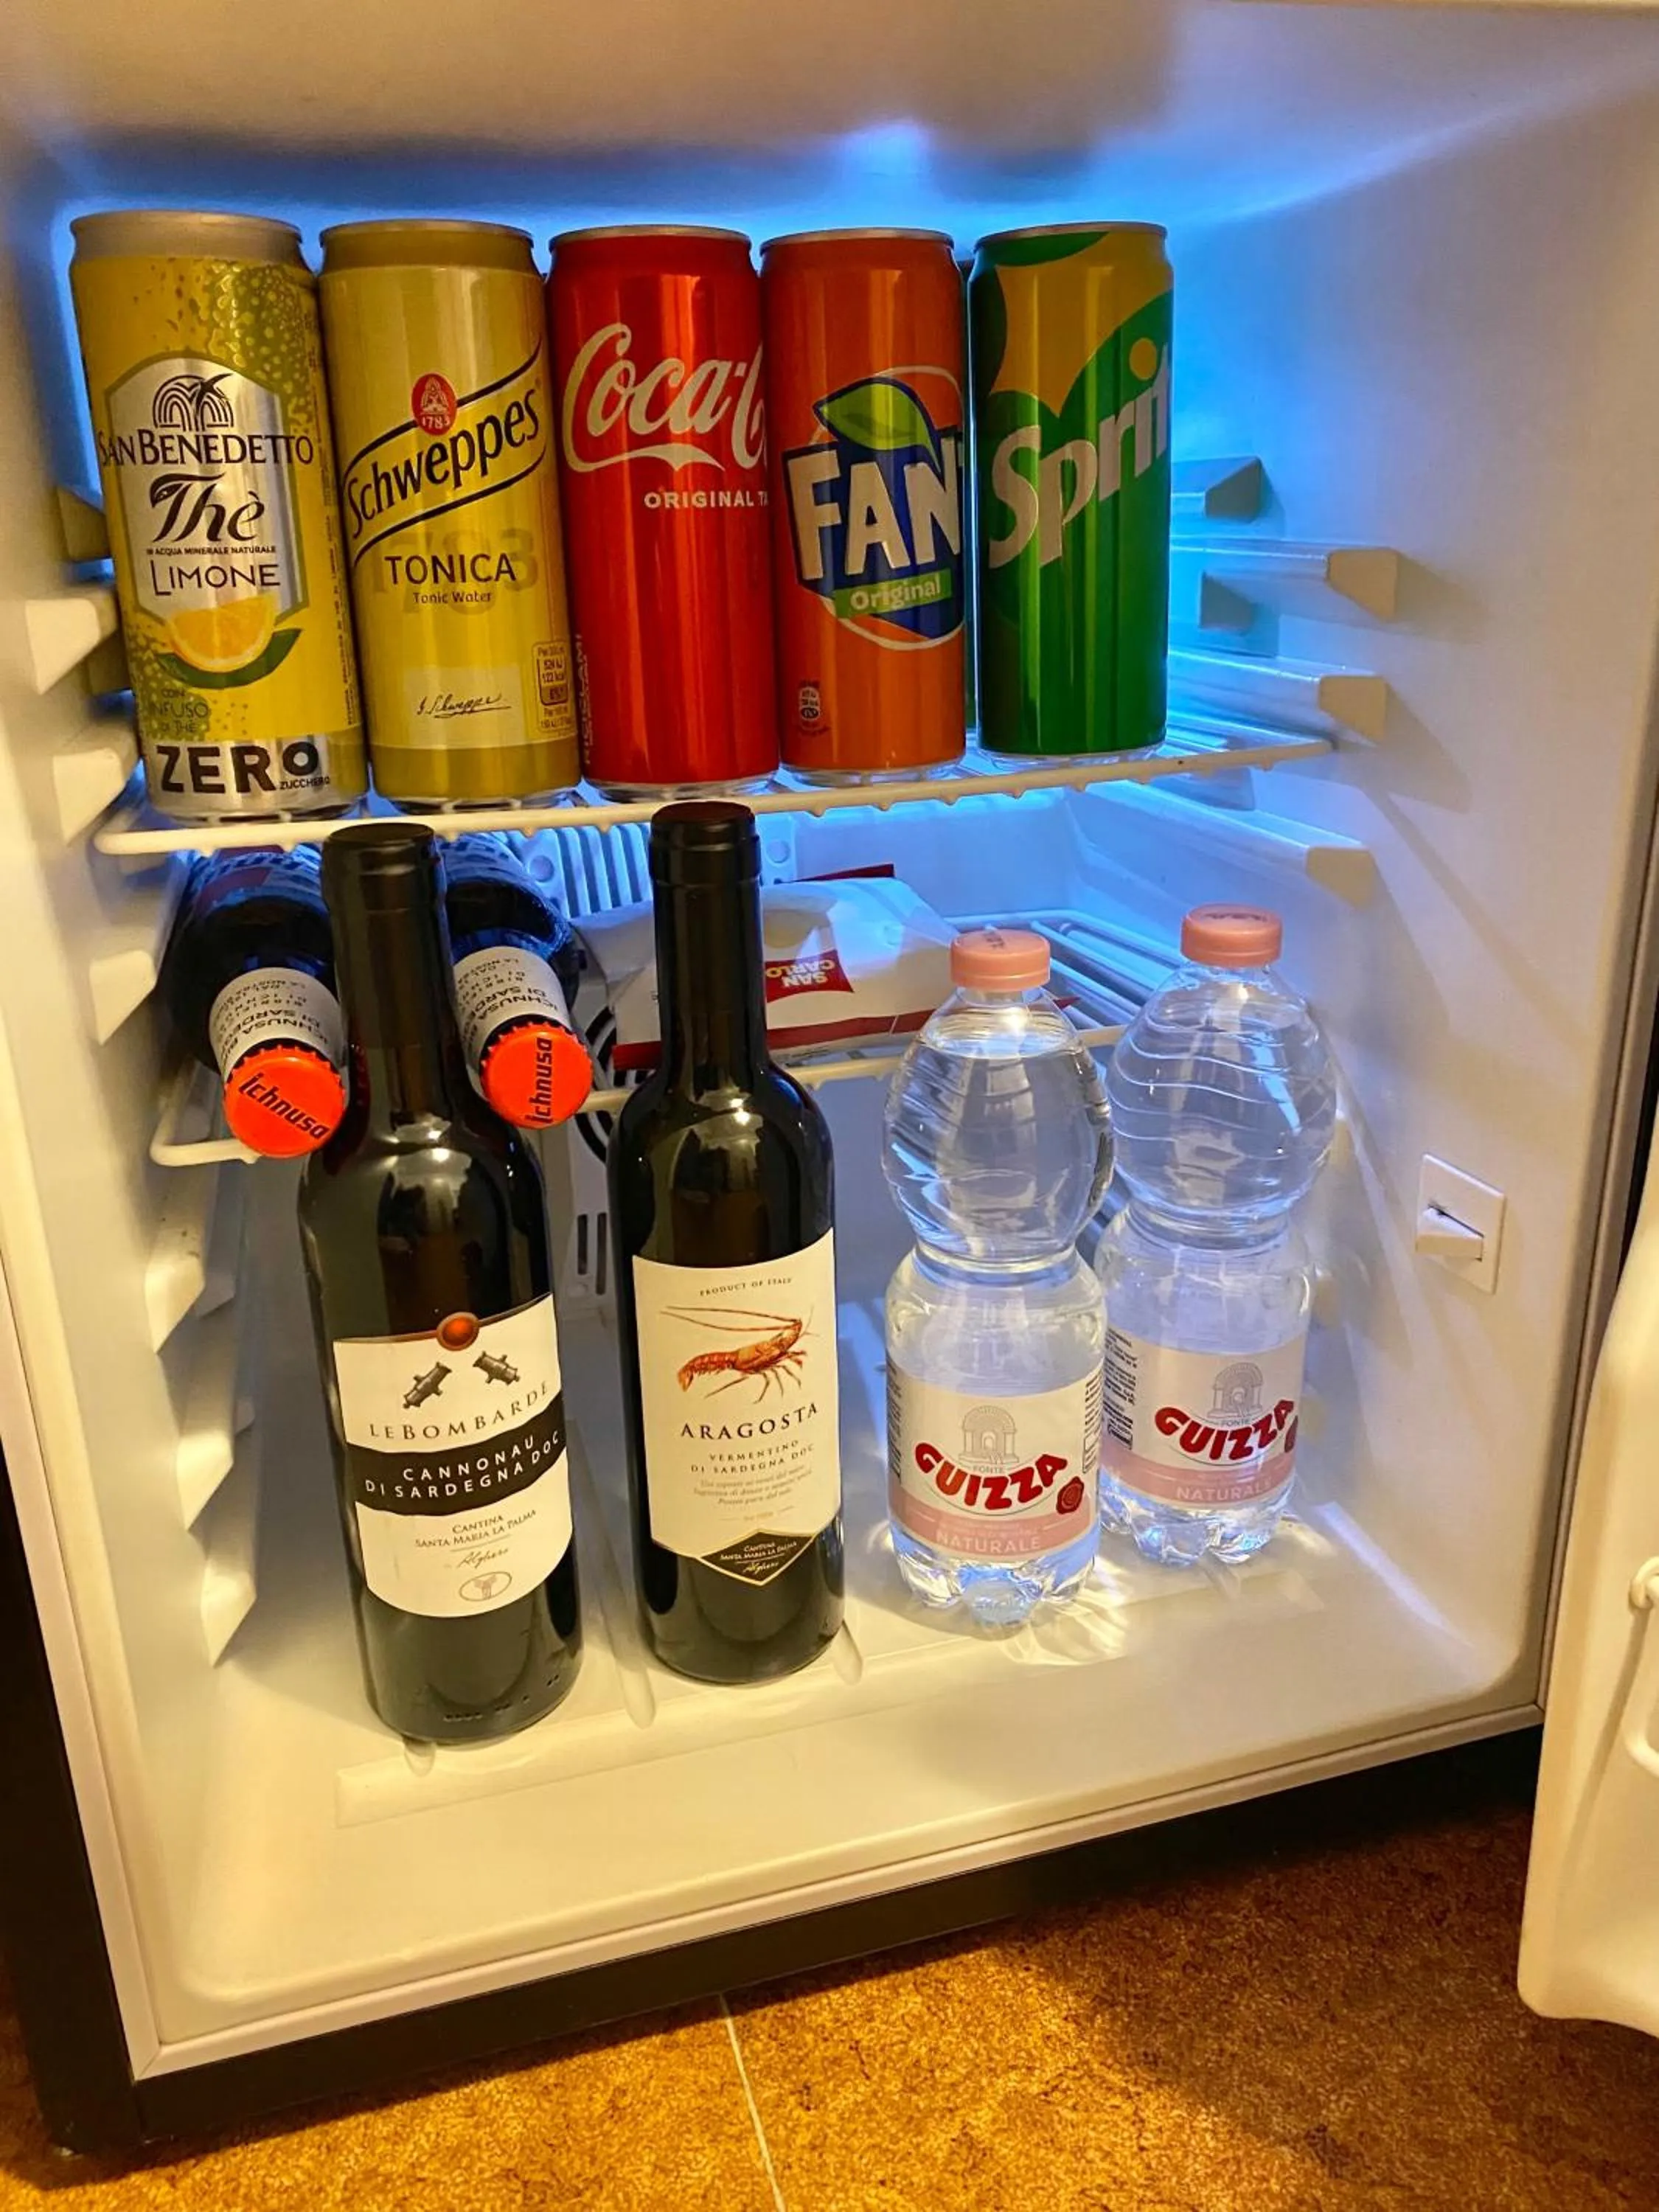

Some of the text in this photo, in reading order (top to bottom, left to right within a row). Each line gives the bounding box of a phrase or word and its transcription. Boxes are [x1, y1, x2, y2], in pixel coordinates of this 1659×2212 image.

[422, 416, 451, 430] 1783
[137, 428, 313, 466] BENEDETTO
[347, 389, 539, 539] Schweppes
[150, 472, 265, 543] Thè
[644, 490, 754, 509] ORIGINAL
[788, 437, 964, 580] FAN
[155, 547, 183, 556] ACQUA
[184, 546, 229, 554] MINERALE
[232, 545, 276, 554] NATURALE
[150, 560, 280, 596] LIMONE
[384, 552, 516, 585] TONICA
[413, 591, 492, 604] Tonic Water
[850, 574, 941, 610] Original
[157, 742, 319, 793] ZERO
[279, 776, 330, 790] ZUCCHERO
[766, 960, 835, 978] CARLO
[782, 972, 829, 987] SAN
[699, 1282, 746, 1297] PRODUCT
[751, 1279, 763, 1287] OF
[680, 1402, 818, 1440] ARAGOSTA
[1155, 1399, 1295, 1461] GUIZZA
[364, 1430, 560, 1499] DI SARDEGNA DOC
[402, 1434, 534, 1482] CANNONAU
[691, 1464, 705, 1474] DI
[713, 1457, 785, 1475] SARDEGNA
[790, 1442, 815, 1461] DOC
[709, 1439, 799, 1463] VERMENTINO
[915, 1442, 1068, 1510] GUIZZA
[414, 1509, 537, 1548] SANTA MARIA LA PALMA
[452, 1514, 504, 1534] CANTINA
[743, 1541, 776, 1552] CANTINA
[744, 1550, 766, 1558] MARIA
[777, 1541, 797, 1554] PALMA
[936, 1528, 1040, 1554] NATURALE
